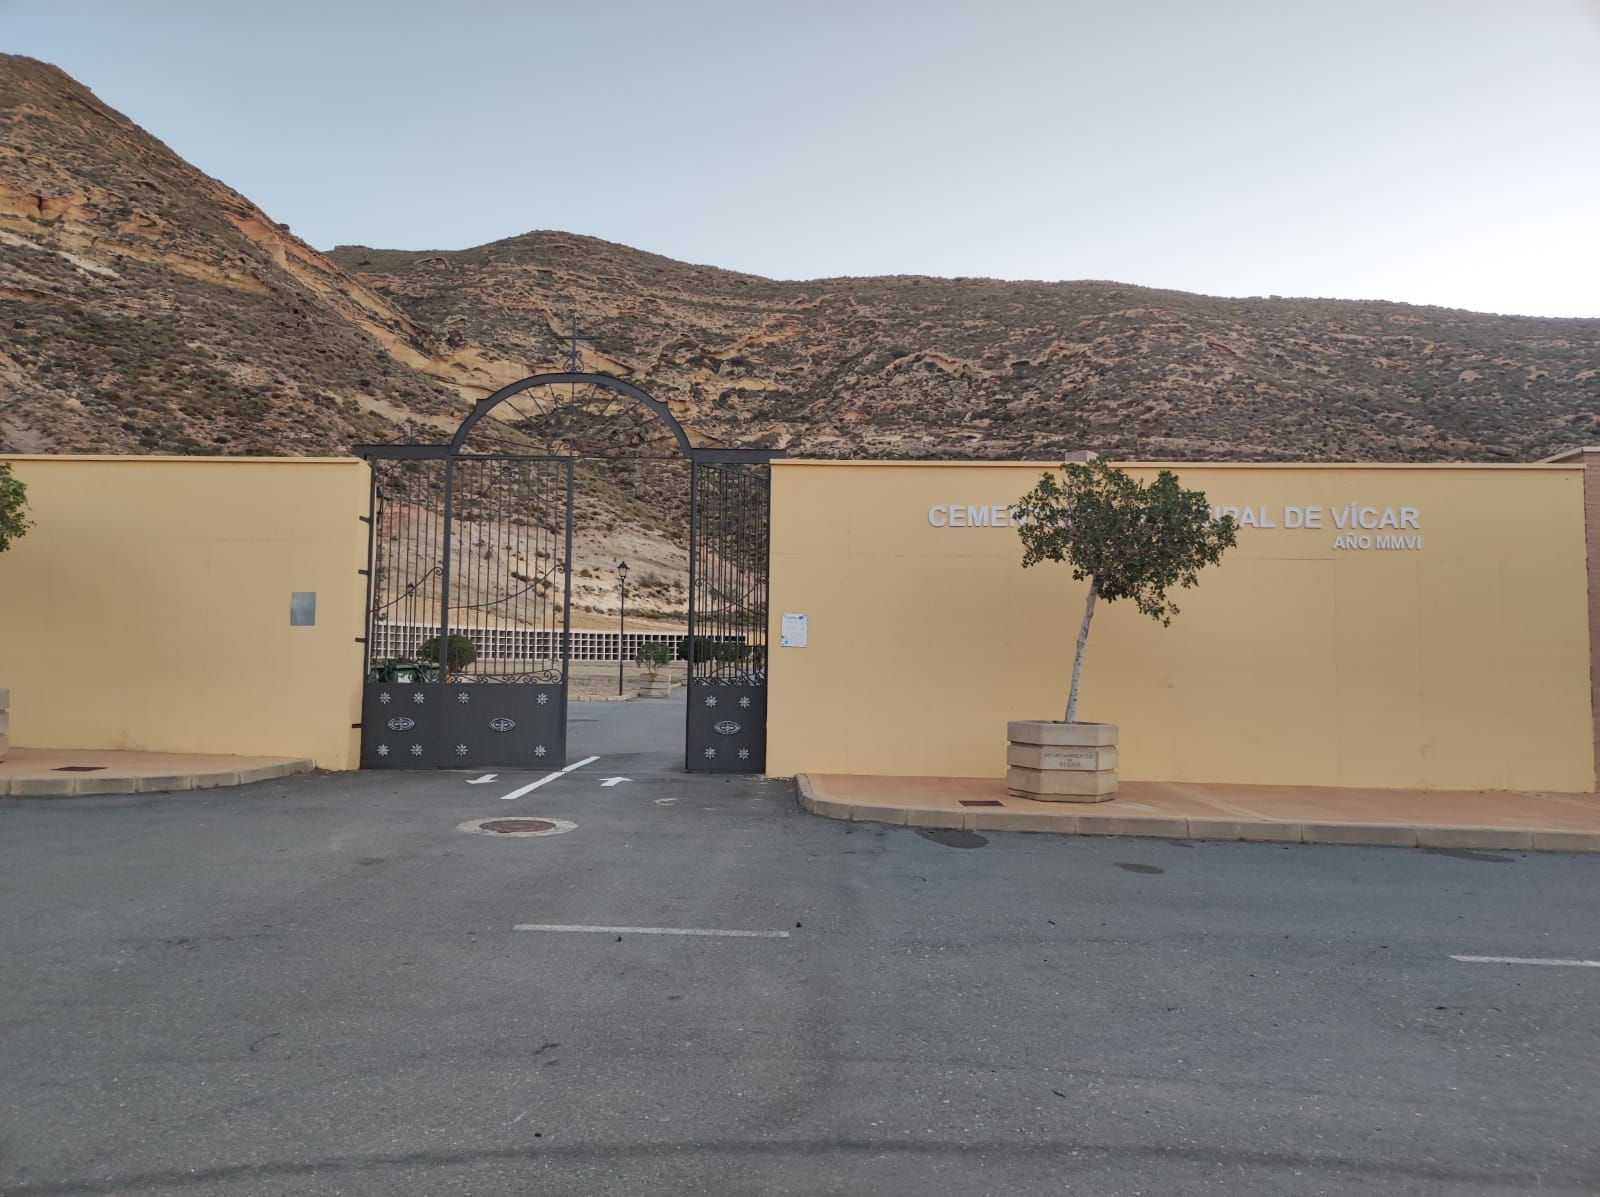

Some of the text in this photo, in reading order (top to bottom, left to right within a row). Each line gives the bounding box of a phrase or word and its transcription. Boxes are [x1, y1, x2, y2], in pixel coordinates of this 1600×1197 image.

[1284, 506, 1323, 529] DE
[1330, 501, 1420, 530] VÍCAR
[1332, 533, 1422, 550] AÑO MMVI
